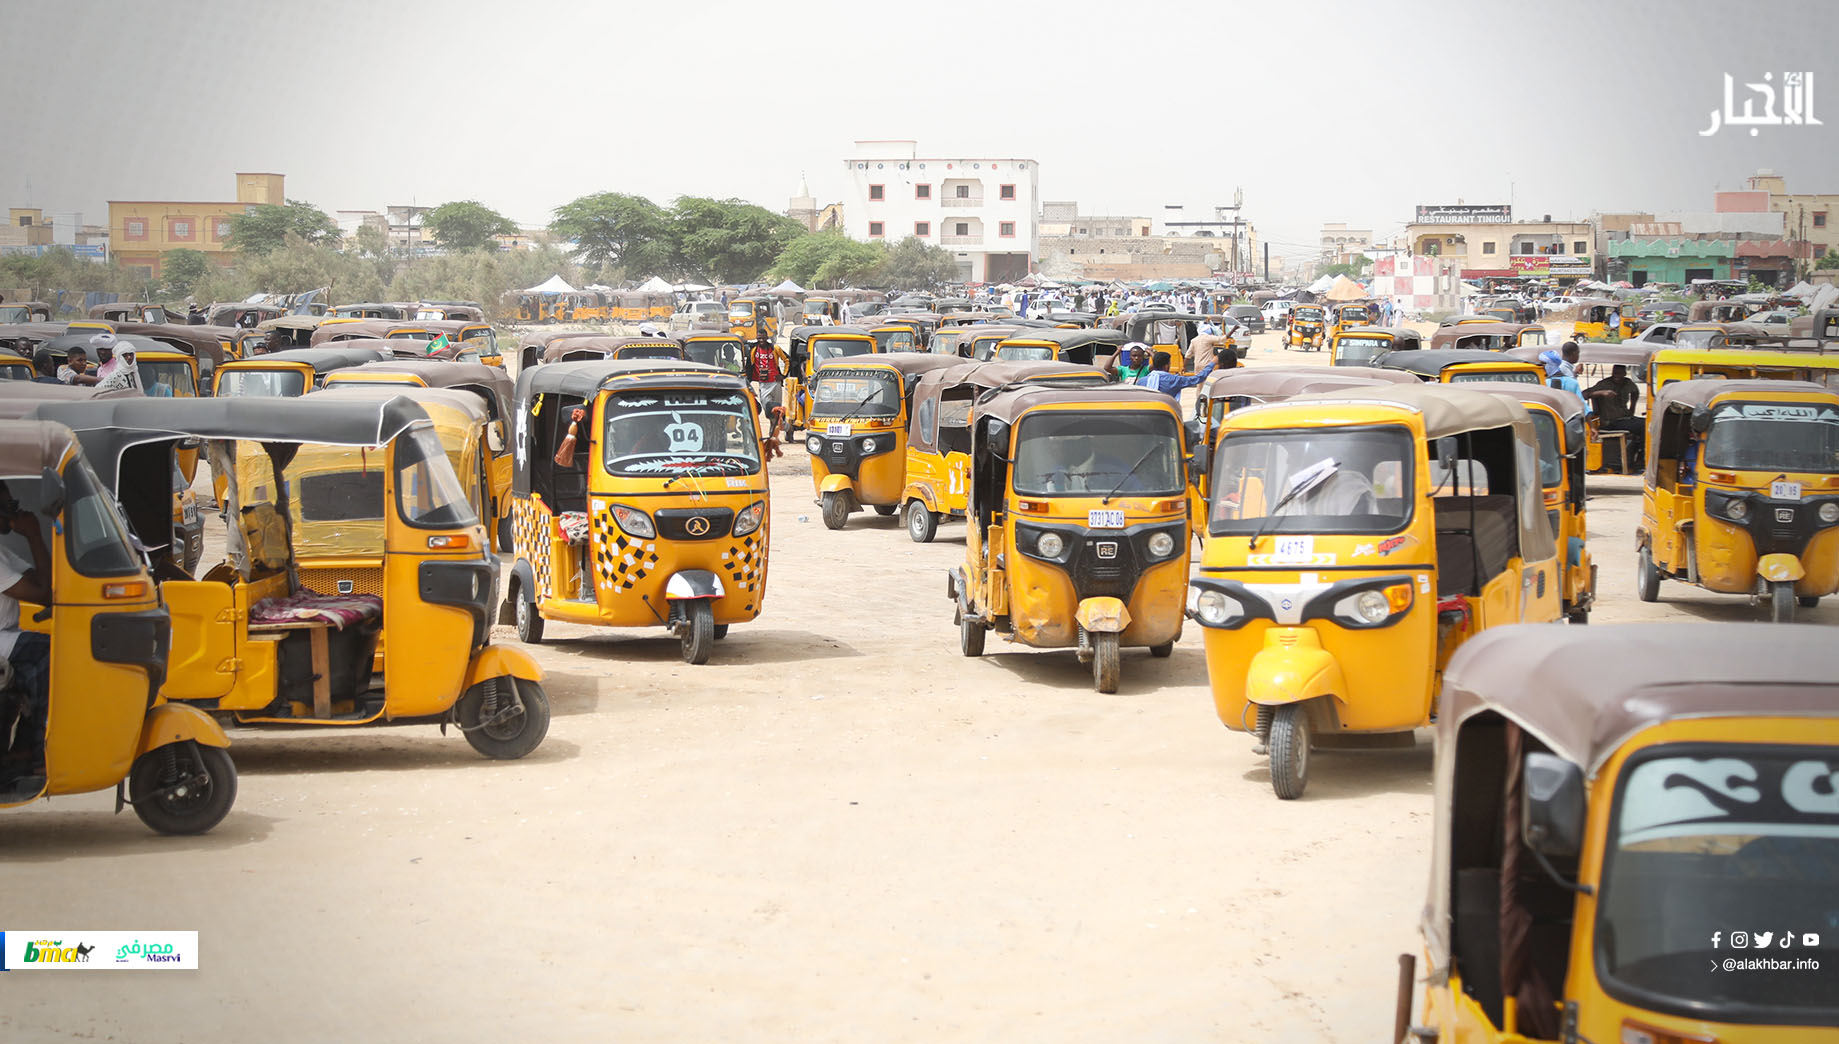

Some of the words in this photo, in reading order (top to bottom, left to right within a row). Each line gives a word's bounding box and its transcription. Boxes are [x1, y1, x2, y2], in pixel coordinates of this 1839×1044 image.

[1418, 215, 1474, 224] RESTAURANT
[1477, 215, 1511, 223] TINIGUI
[672, 428, 698, 442] 04
[1090, 511, 1104, 526] 3731
